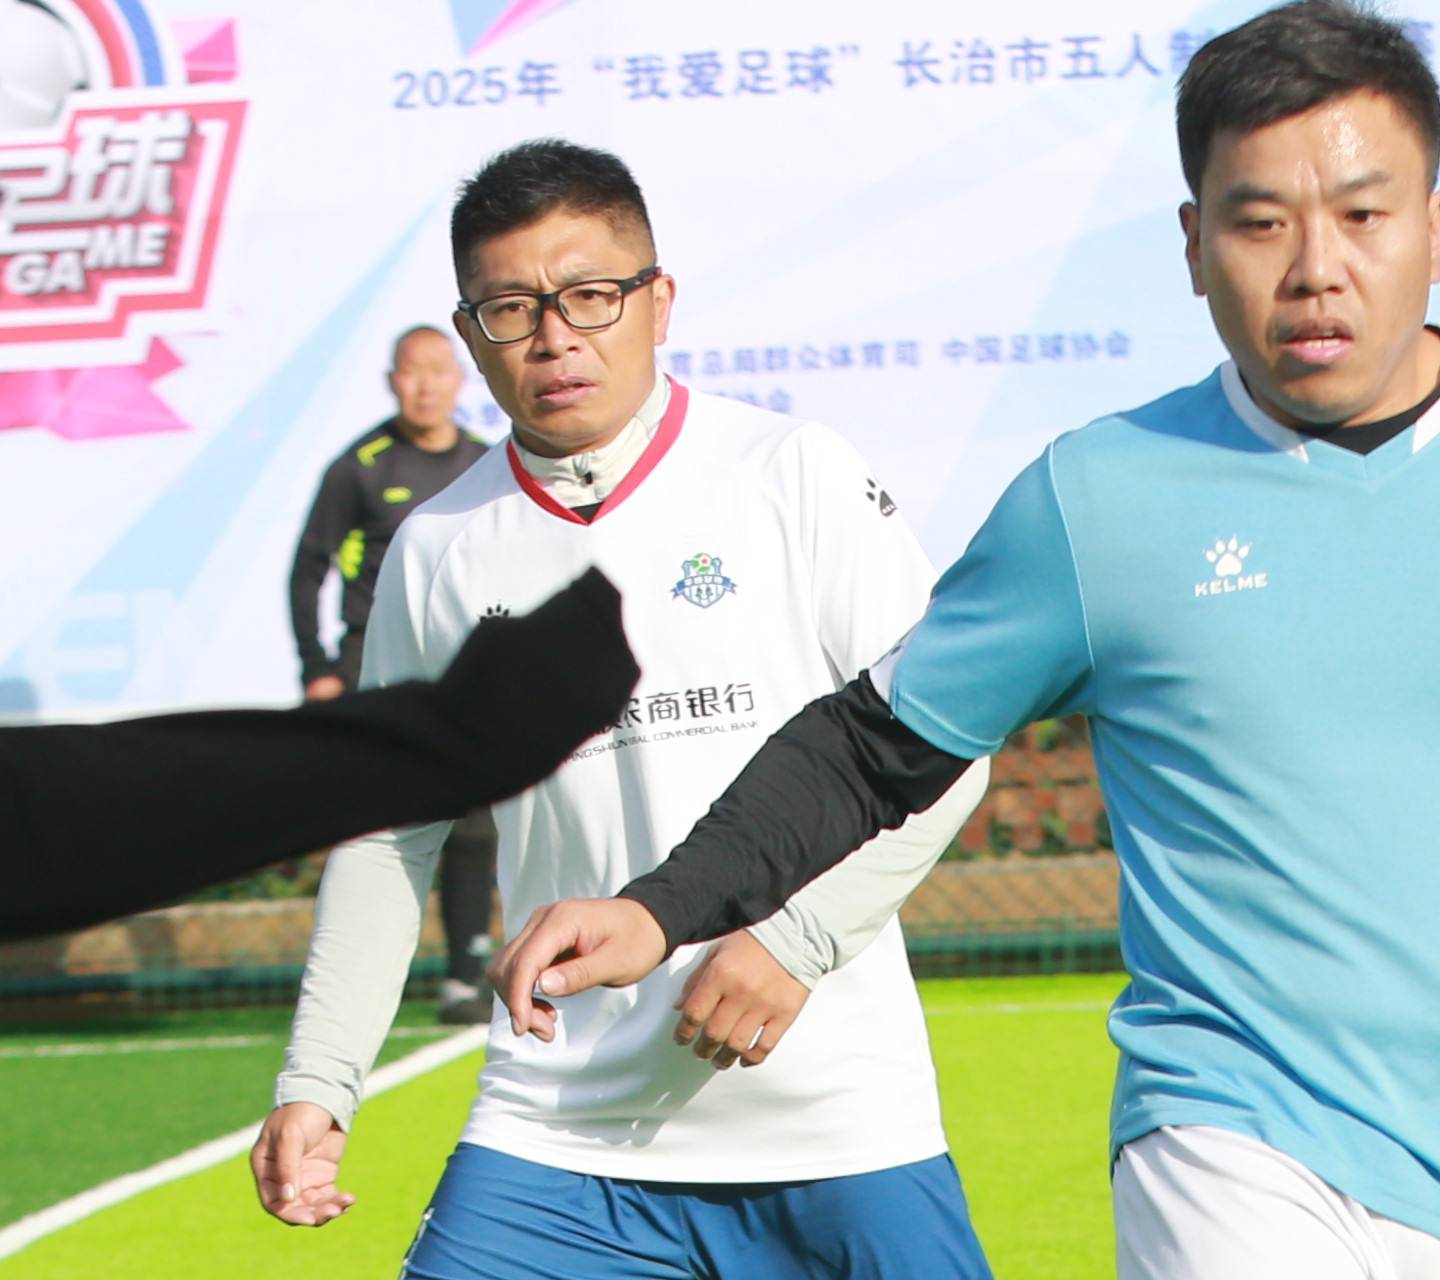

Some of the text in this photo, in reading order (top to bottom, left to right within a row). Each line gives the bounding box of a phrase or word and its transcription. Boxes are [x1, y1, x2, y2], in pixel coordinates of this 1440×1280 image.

[3, 222, 171, 296] GAME
[1194, 572, 1269, 598] KELME
[602, 683, 757, 734] 农商银行
